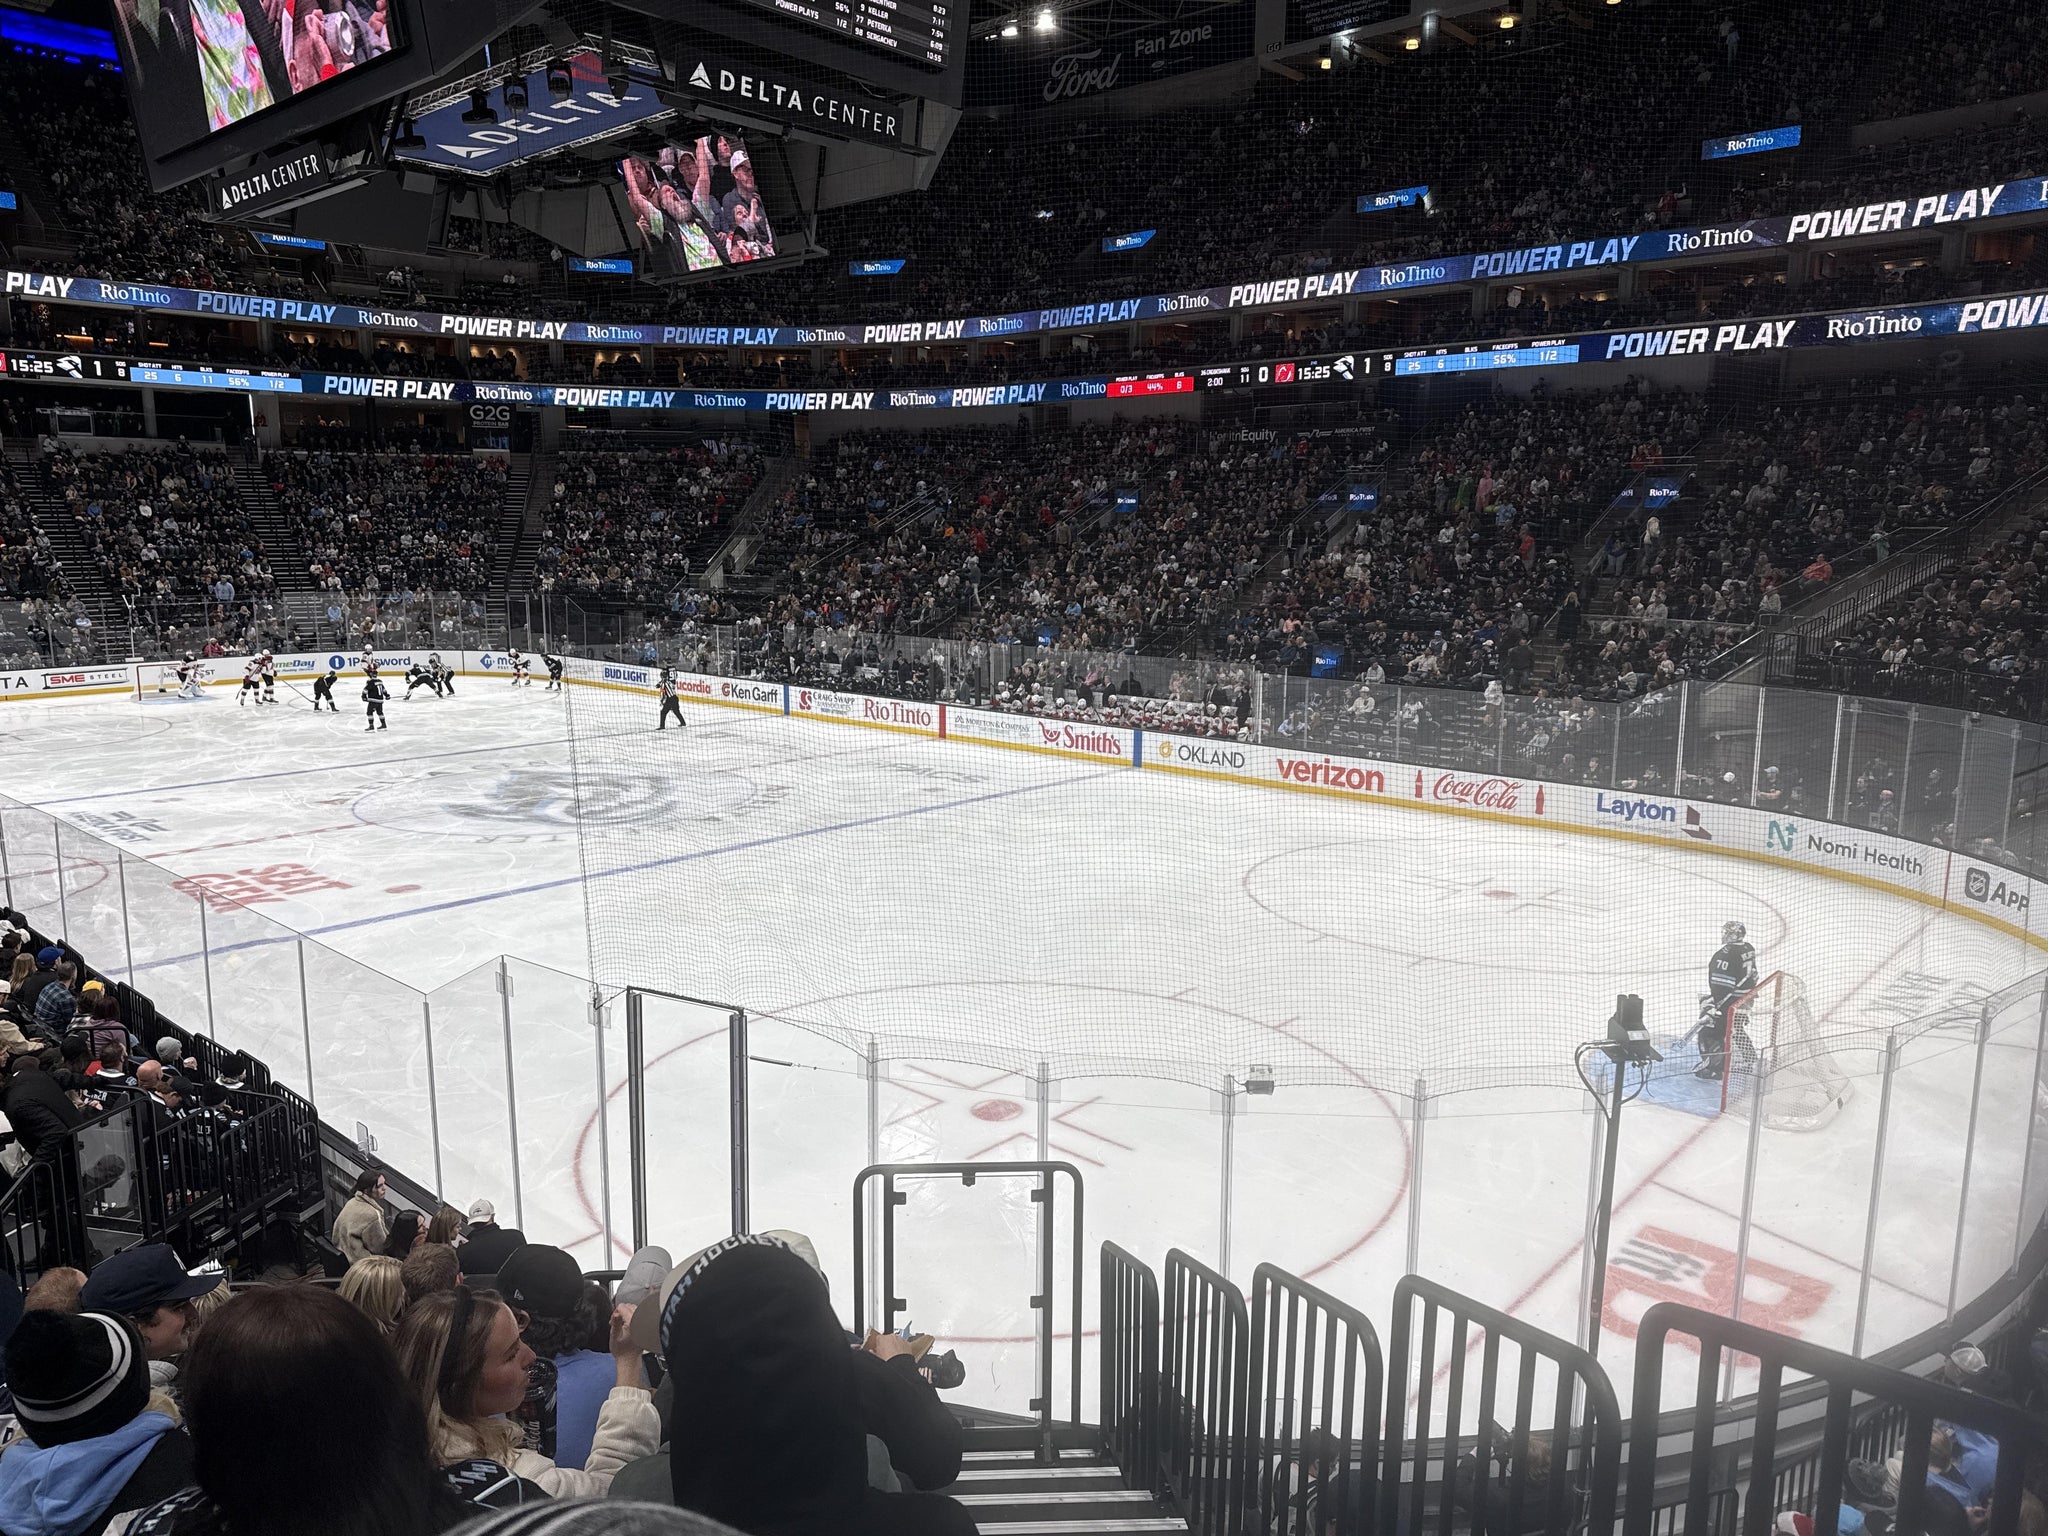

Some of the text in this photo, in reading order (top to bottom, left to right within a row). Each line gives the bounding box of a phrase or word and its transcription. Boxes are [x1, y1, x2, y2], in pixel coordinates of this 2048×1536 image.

[775, 0, 848, 29] POWER PLAYS 1/2
[835, 2, 850, 14] 56%
[860, 3, 865, 11] 9
[868, 6, 889, 19] KELLER
[856, 15, 864, 23] 77
[867, 18, 892, 33] PETERKA
[854, 27, 863, 36] 98
[866, 31, 898, 47] SERGACHEV
[1134, 25, 1212, 57] Fan Zone
[1043, 48, 1122, 101] Ford
[719, 69, 896, 136] DELTA CENTER
[467, 91, 643, 145] DELTA
[231, 154, 320, 203] DELTA CENTER
[1786, 200, 1906, 243] POWER
[1912, 184, 2005, 227] PLAY
[1470, 235, 1639, 279] POWER PLAY
[6, 272, 74, 298] PLAY
[1229, 270, 1359, 307] POWER PLAY
[197, 292, 336, 324] POWER PLAY
[1039, 299, 1141, 330] POWER PLAY
[1958, 295, 2048, 332] POW
[440, 316, 567, 340] POWER PLAY
[663, 326, 779, 345] POWER PLAY
[864, 319, 965, 343] POWER PLAY
[1531, 338, 1566, 348] POWER PLAY
[1605, 320, 1796, 359] POWER PLAY
[1437, 358, 1444, 369] 6
[1465, 356, 1477, 367] 11
[1493, 353, 1516, 365] 56%
[1539, 350, 1557, 362] 1/2
[11, 359, 54, 374] 15:25
[93, 360, 102, 376] 1
[118, 368, 125, 377] 8
[1258, 366, 1269, 382] 0
[1298, 365, 1330, 380] 15:25
[1364, 357, 1371, 374] 1
[1384, 361, 1391, 372] 8
[1408, 360, 1421, 371] 25
[144, 371, 158, 381] 25
[174, 373, 182, 382] 6
[201, 375, 213, 384] 11
[228, 376, 250, 387] 56%
[269, 379, 285, 389] 1/2
[1240, 374, 1250, 383] 11
[324, 375, 455, 400] POWER PLAY
[952, 383, 1046, 407] POWER PLAY
[1120, 384, 1133, 394] 0/3
[553, 388, 676, 408] POWER PLAY
[765, 392, 874, 410] POWER PLAY
[469, 404, 510, 421] G2G
[347, 656, 411, 667] 1Psword
[50, 672, 123, 685] SME STEEL
[604, 668, 648, 683] BUD LIGHT
[675, 679, 712, 695] ucordia
[731, 684, 778, 704] Ken Garff
[813, 691, 833, 702] CRAIG
[1063, 724, 1121, 756] Smith's
[1178, 744, 1245, 769] OKLAND
[1276, 758, 1384, 793] verizon
[1433, 772, 1523, 811] Coca-Cola
[1596, 792, 1676, 822] Layton
[1807, 834, 1923, 877] Nomi Health
[1716, 959, 1729, 971] 70
[661, 1232, 784, 1349] UTAH HOCKEY
